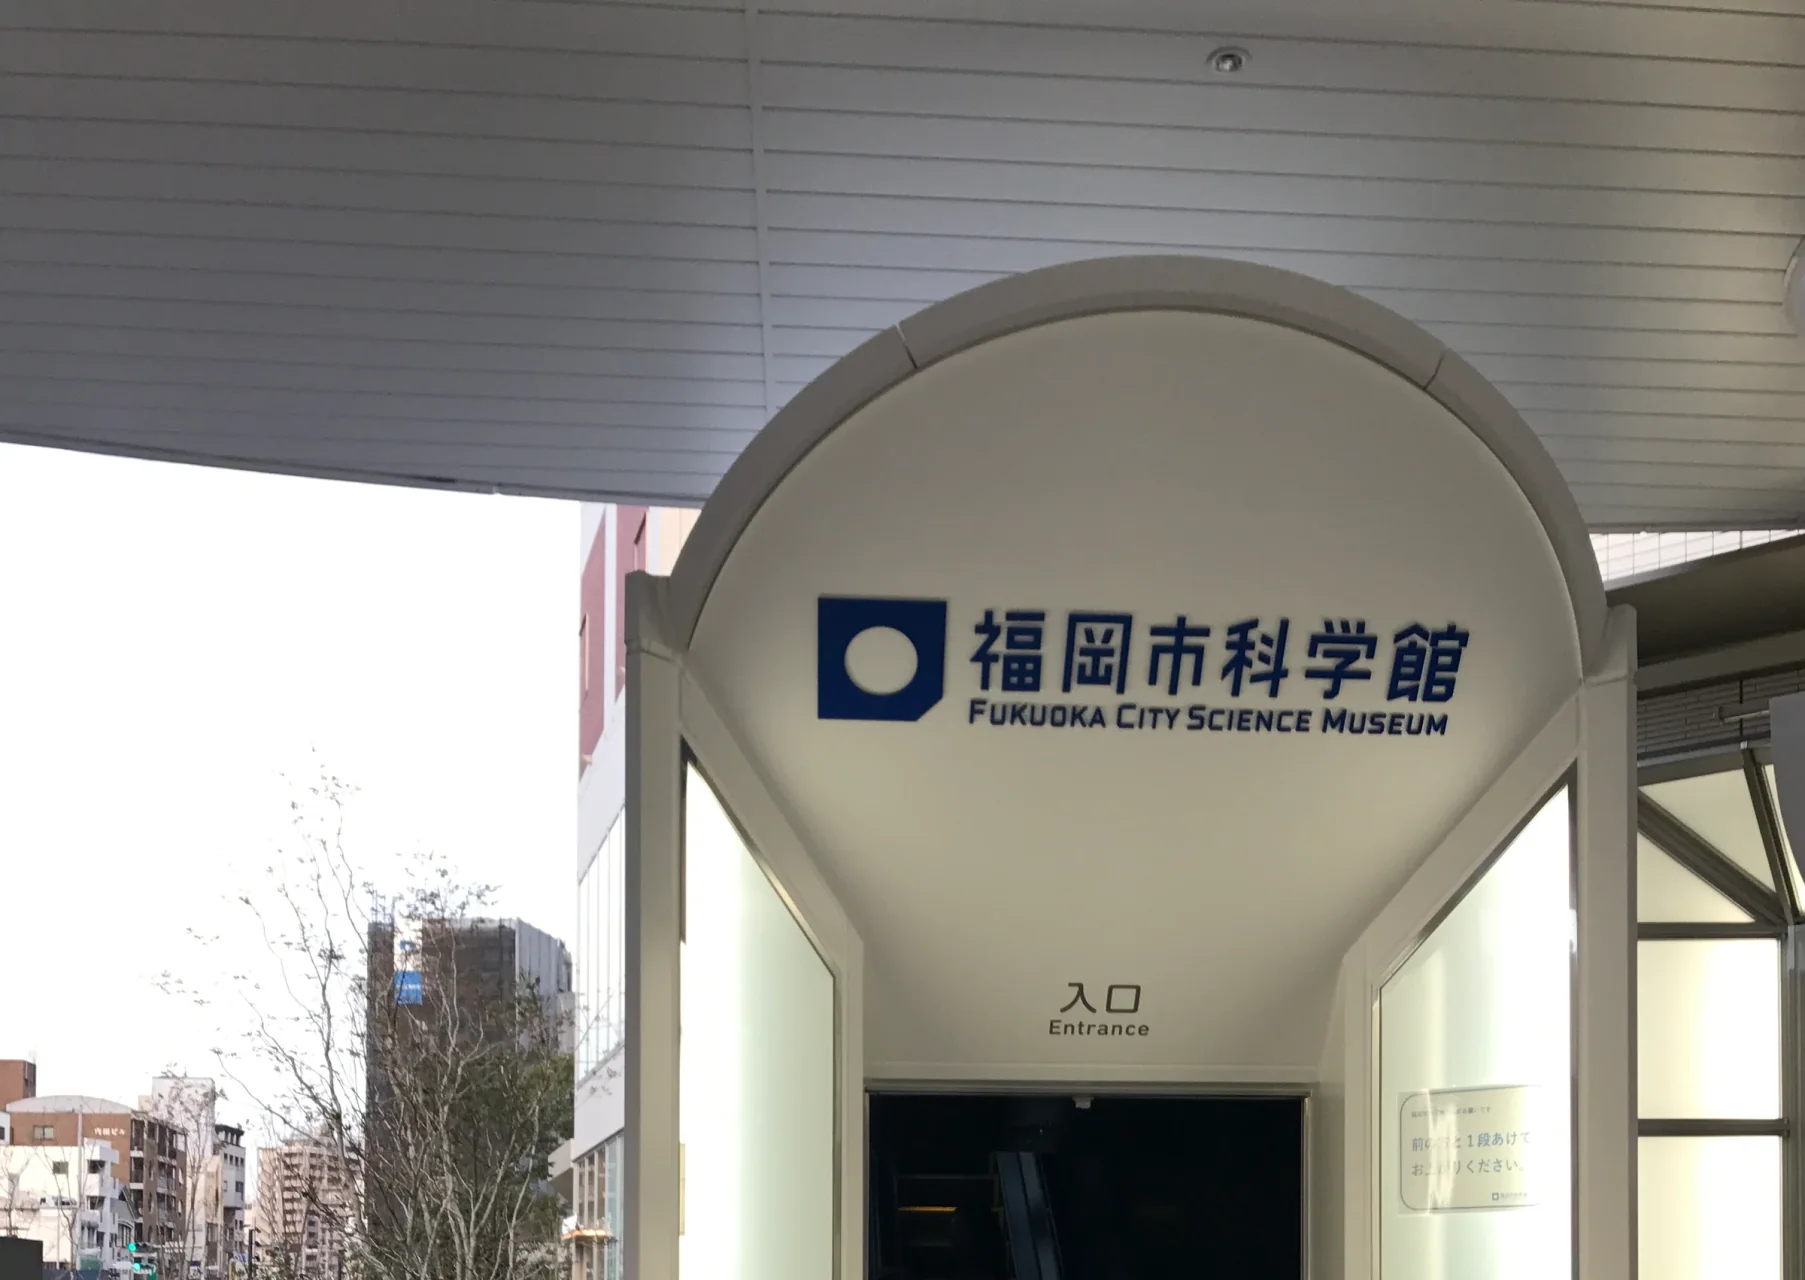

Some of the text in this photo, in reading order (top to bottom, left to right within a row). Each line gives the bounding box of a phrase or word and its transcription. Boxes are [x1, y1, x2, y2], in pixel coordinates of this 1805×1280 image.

[968, 610, 1470, 703] 福岡市科学館
[969, 698, 1449, 736] FUKUOKA CITY SCIENCE MUSEUM
[1060, 982, 1141, 1013] 入口
[1049, 1019, 1150, 1036] Entrance
[1411, 1131, 1531, 1152] 前のと1段あけて
